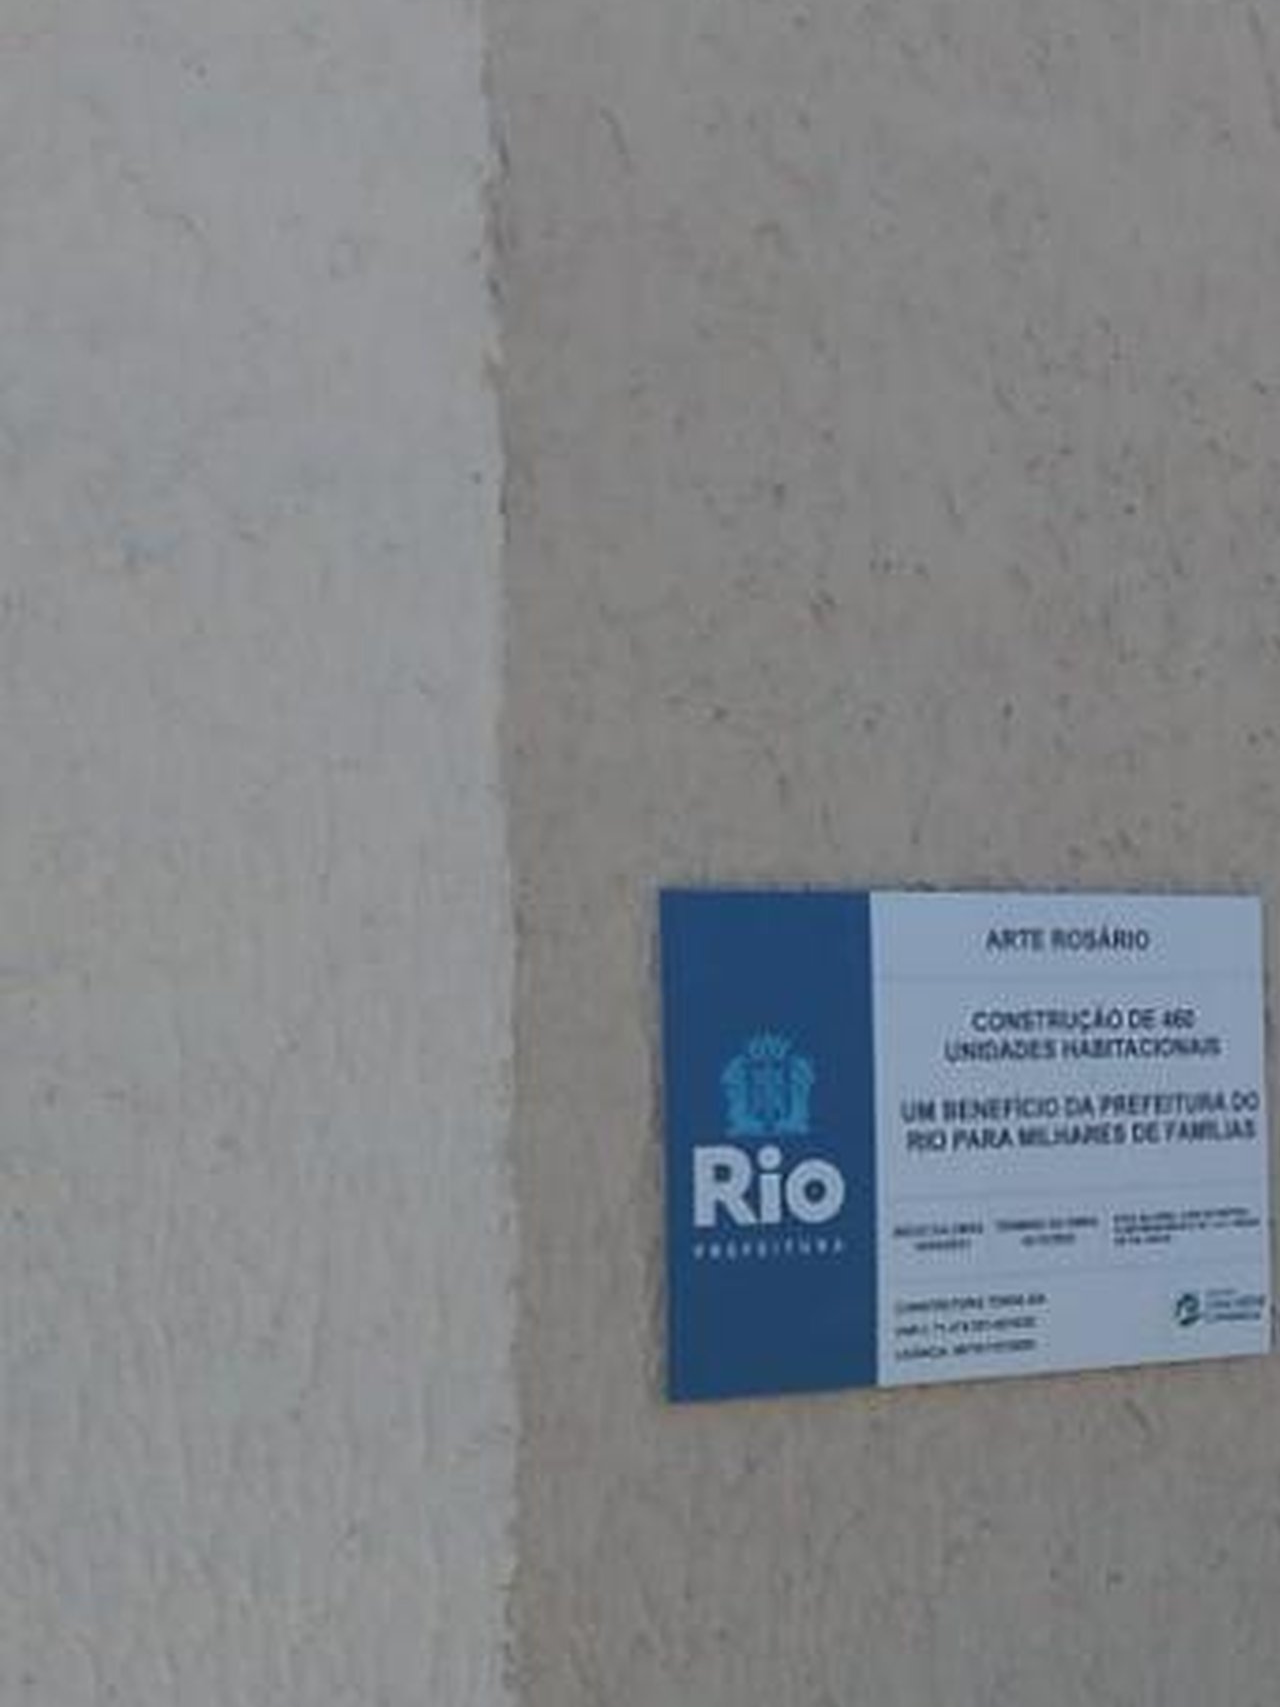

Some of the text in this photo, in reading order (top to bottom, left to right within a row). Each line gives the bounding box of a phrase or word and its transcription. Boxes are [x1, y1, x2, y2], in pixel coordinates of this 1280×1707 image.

[985, 923, 1151, 951] ARTE ROSÁRIO
[970, 1007, 1123, 1035] CONSTRUÇÃO
[1128, 1007, 1156, 1031] DE
[943, 1036, 1223, 1063] UNIDADES HABITACIONAIS
[901, 1099, 937, 1124] UM
[1064, 1096, 1096, 1119] DA
[1101, 1093, 1226, 1117] PREFEITURA
[1231, 1090, 1261, 1112] DO
[907, 1129, 947, 1152] RIO
[952, 1127, 1014, 1151] PARA
[1018, 1122, 1127, 1148] MILHARES
[1132, 1121, 1161, 1144] DE
[694, 1144, 846, 1228] Rio
